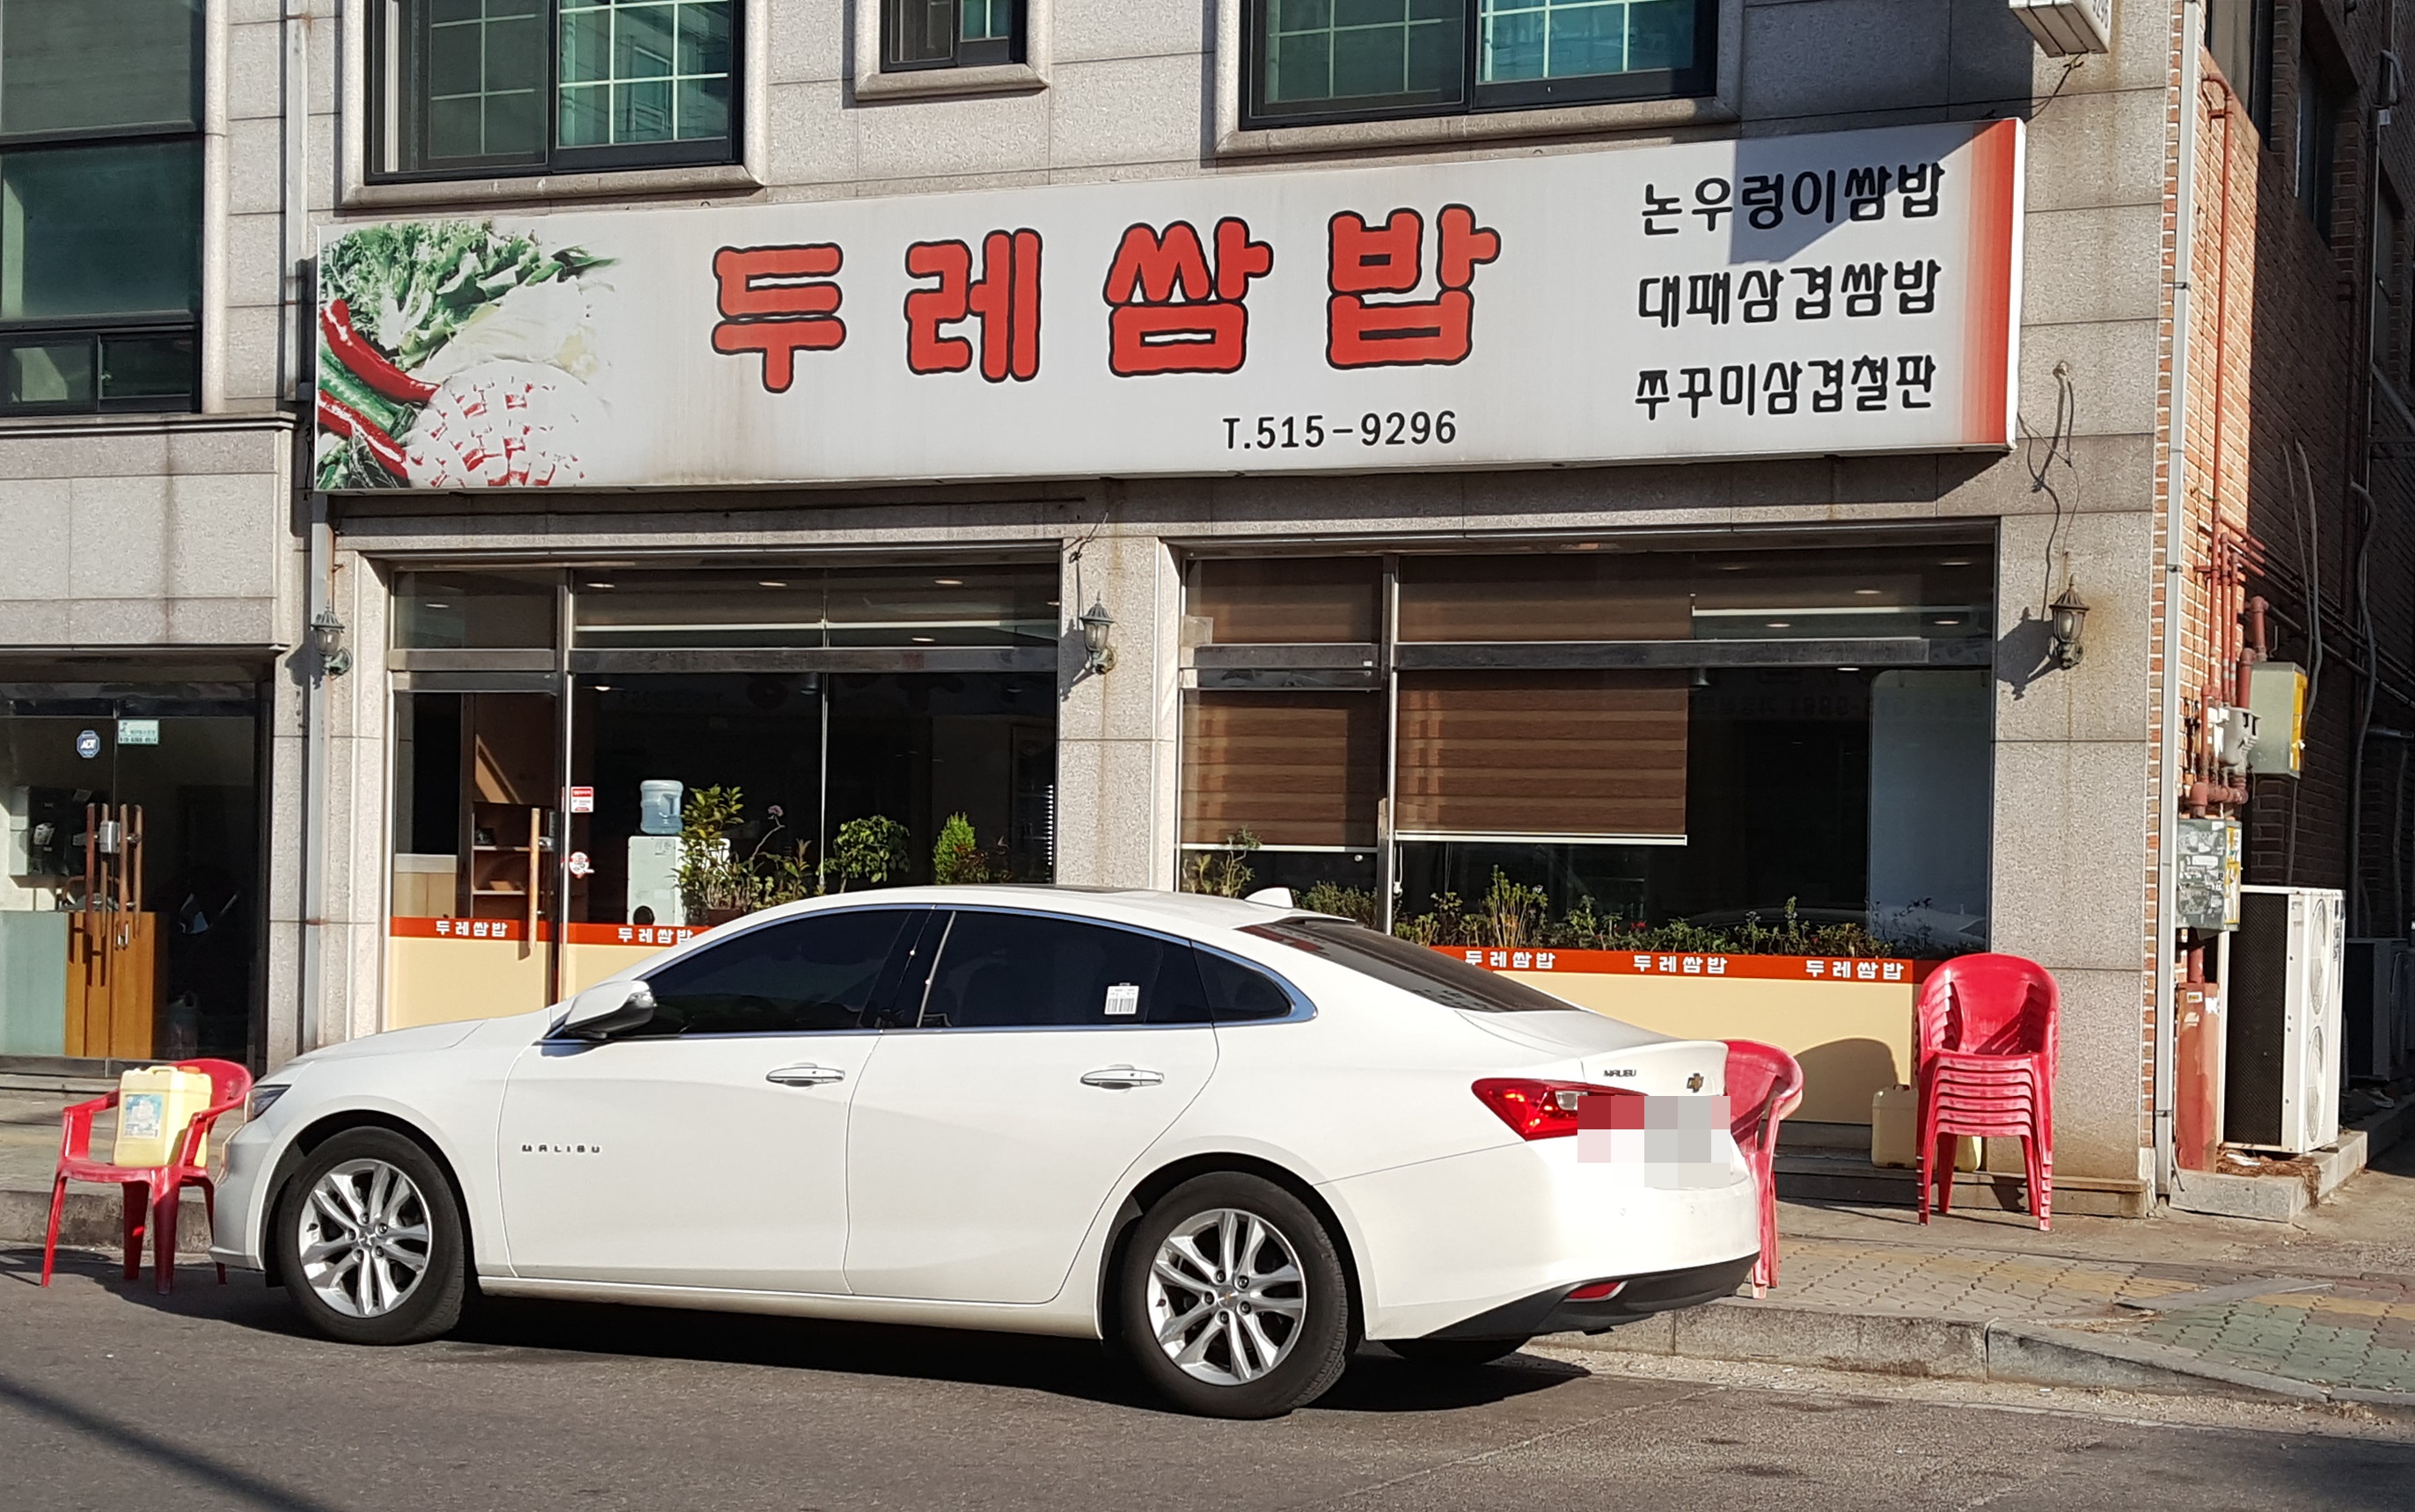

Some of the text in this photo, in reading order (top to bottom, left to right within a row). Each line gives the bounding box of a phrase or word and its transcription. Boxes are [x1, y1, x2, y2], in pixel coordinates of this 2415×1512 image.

[1642, 162, 1945, 236] 논우렁이쌈밥
[710, 202, 1502, 394] 두레쌈밥
[1638, 258, 1942, 328] 대패삼겹쌈밥
[1635, 354, 1936, 421] 쭈꾸미삼겹철판
[1222, 410, 1457, 449] T.515-9296
[435, 920, 508, 938] 두레쌈밥
[1465, 950, 1556, 969] 두레쌈밥
[1633, 954, 1728, 975] 두레쌈밥
[1805, 960, 1905, 980] 두레쌈밥
[1603, 1069, 1637, 1077] MALIBU
[522, 1144, 601, 1153] MALIBU
